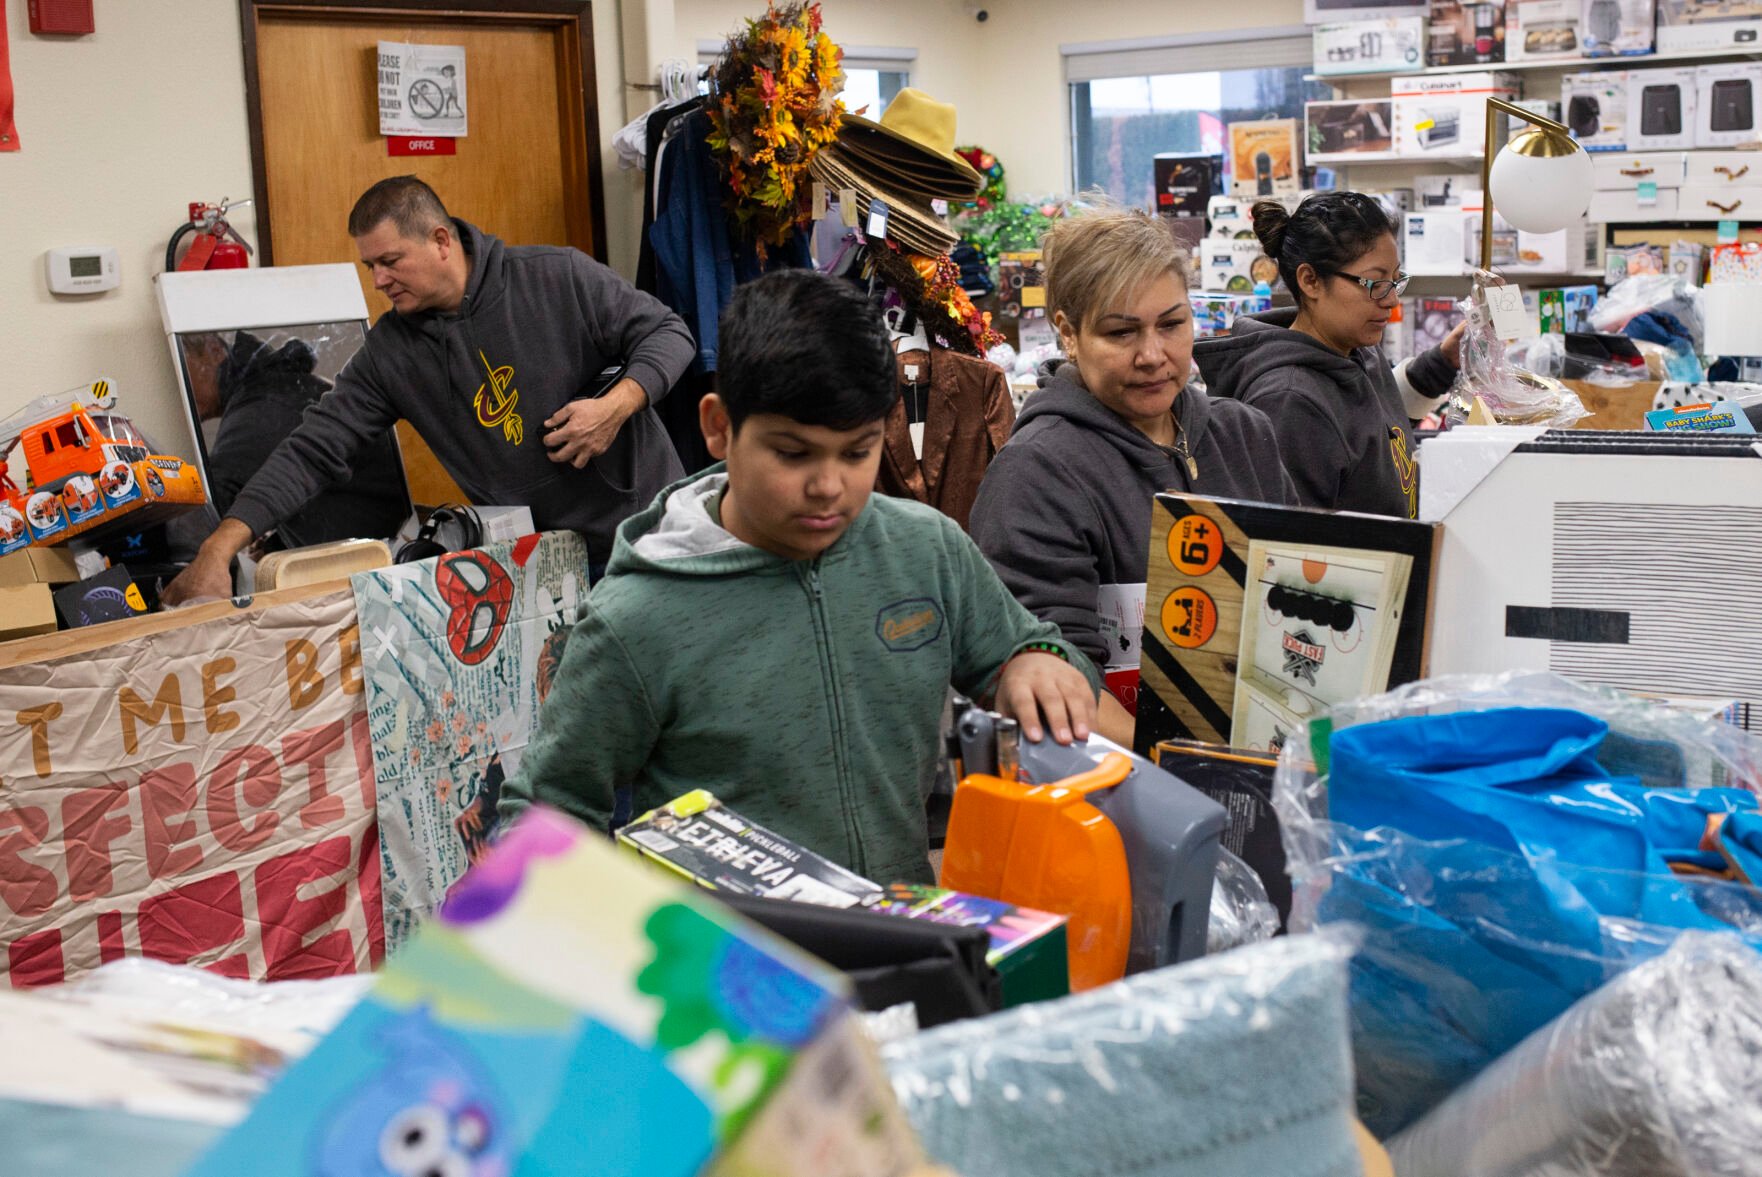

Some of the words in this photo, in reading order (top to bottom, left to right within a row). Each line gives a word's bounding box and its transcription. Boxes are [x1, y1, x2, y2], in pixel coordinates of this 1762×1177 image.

[408, 140, 435, 150] OFFICE
[1665, 419, 1690, 428] BABY
[1691, 413, 1733, 424] SHARK'S
[1193, 599, 1205, 630] PLAYERS
[118, 656, 241, 756] ME
[744, 830, 802, 863] PICKLEBALL
